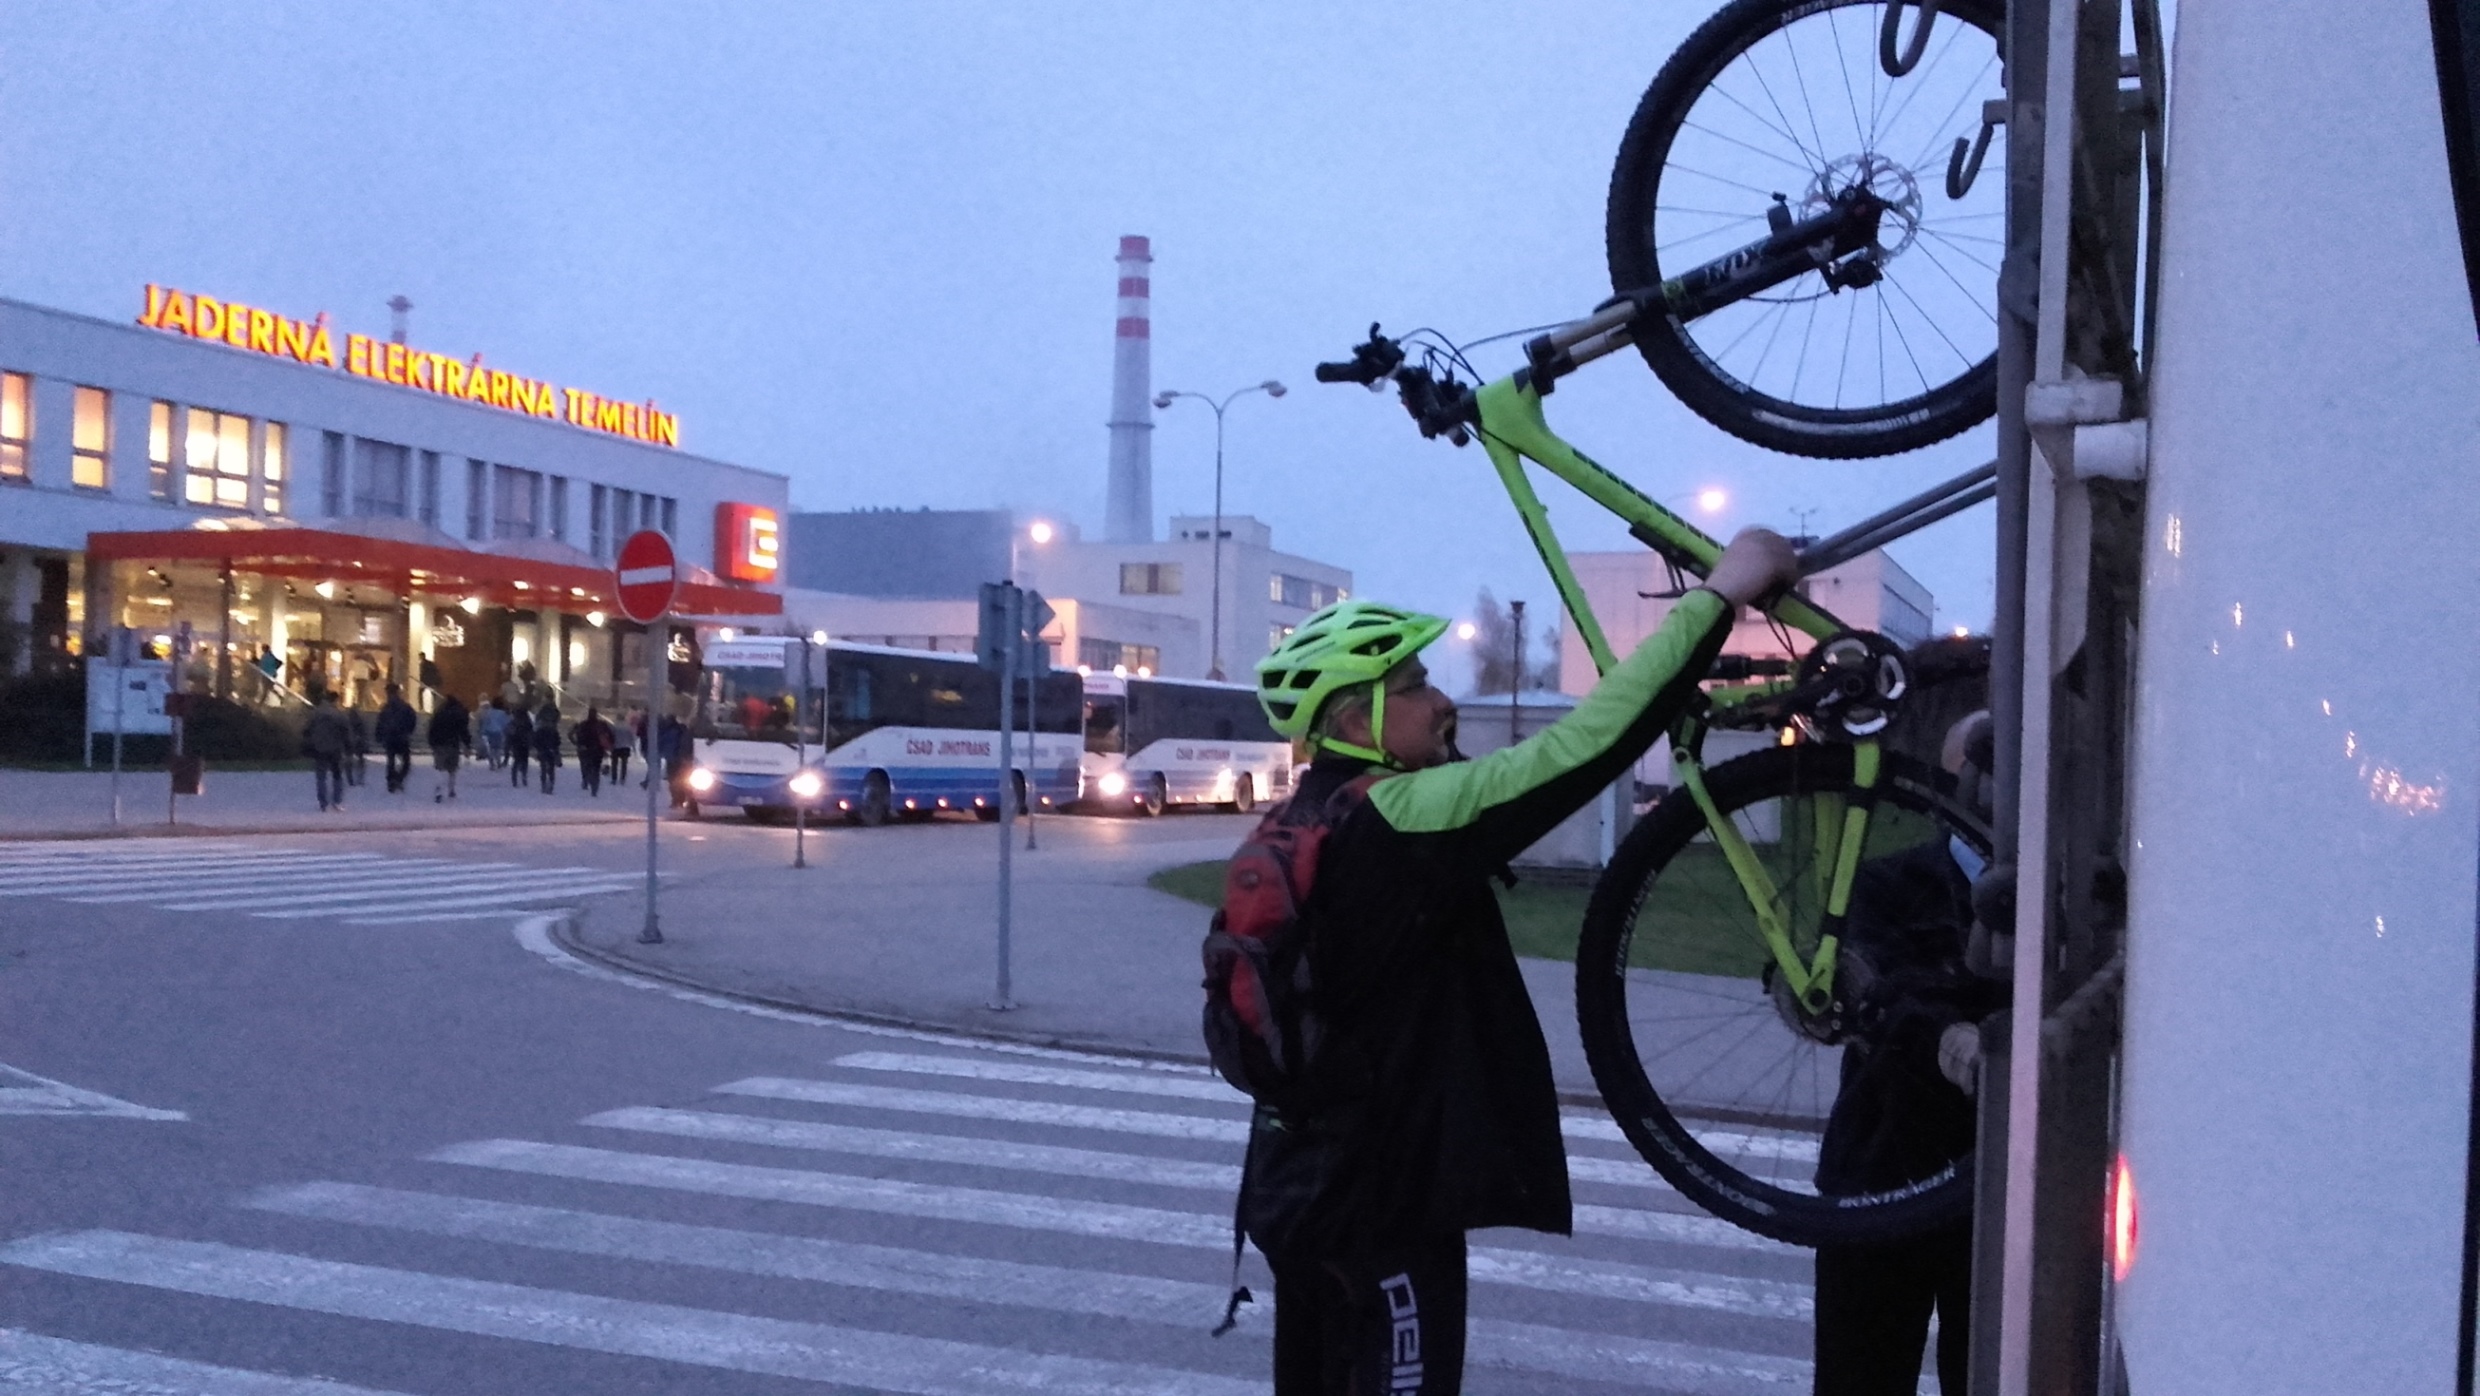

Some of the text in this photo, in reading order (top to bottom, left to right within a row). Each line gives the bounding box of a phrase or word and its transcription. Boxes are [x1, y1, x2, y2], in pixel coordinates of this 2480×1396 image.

[136, 283, 679, 447] JADERNÁ ELEKTRÁRNA TEMELÍN
